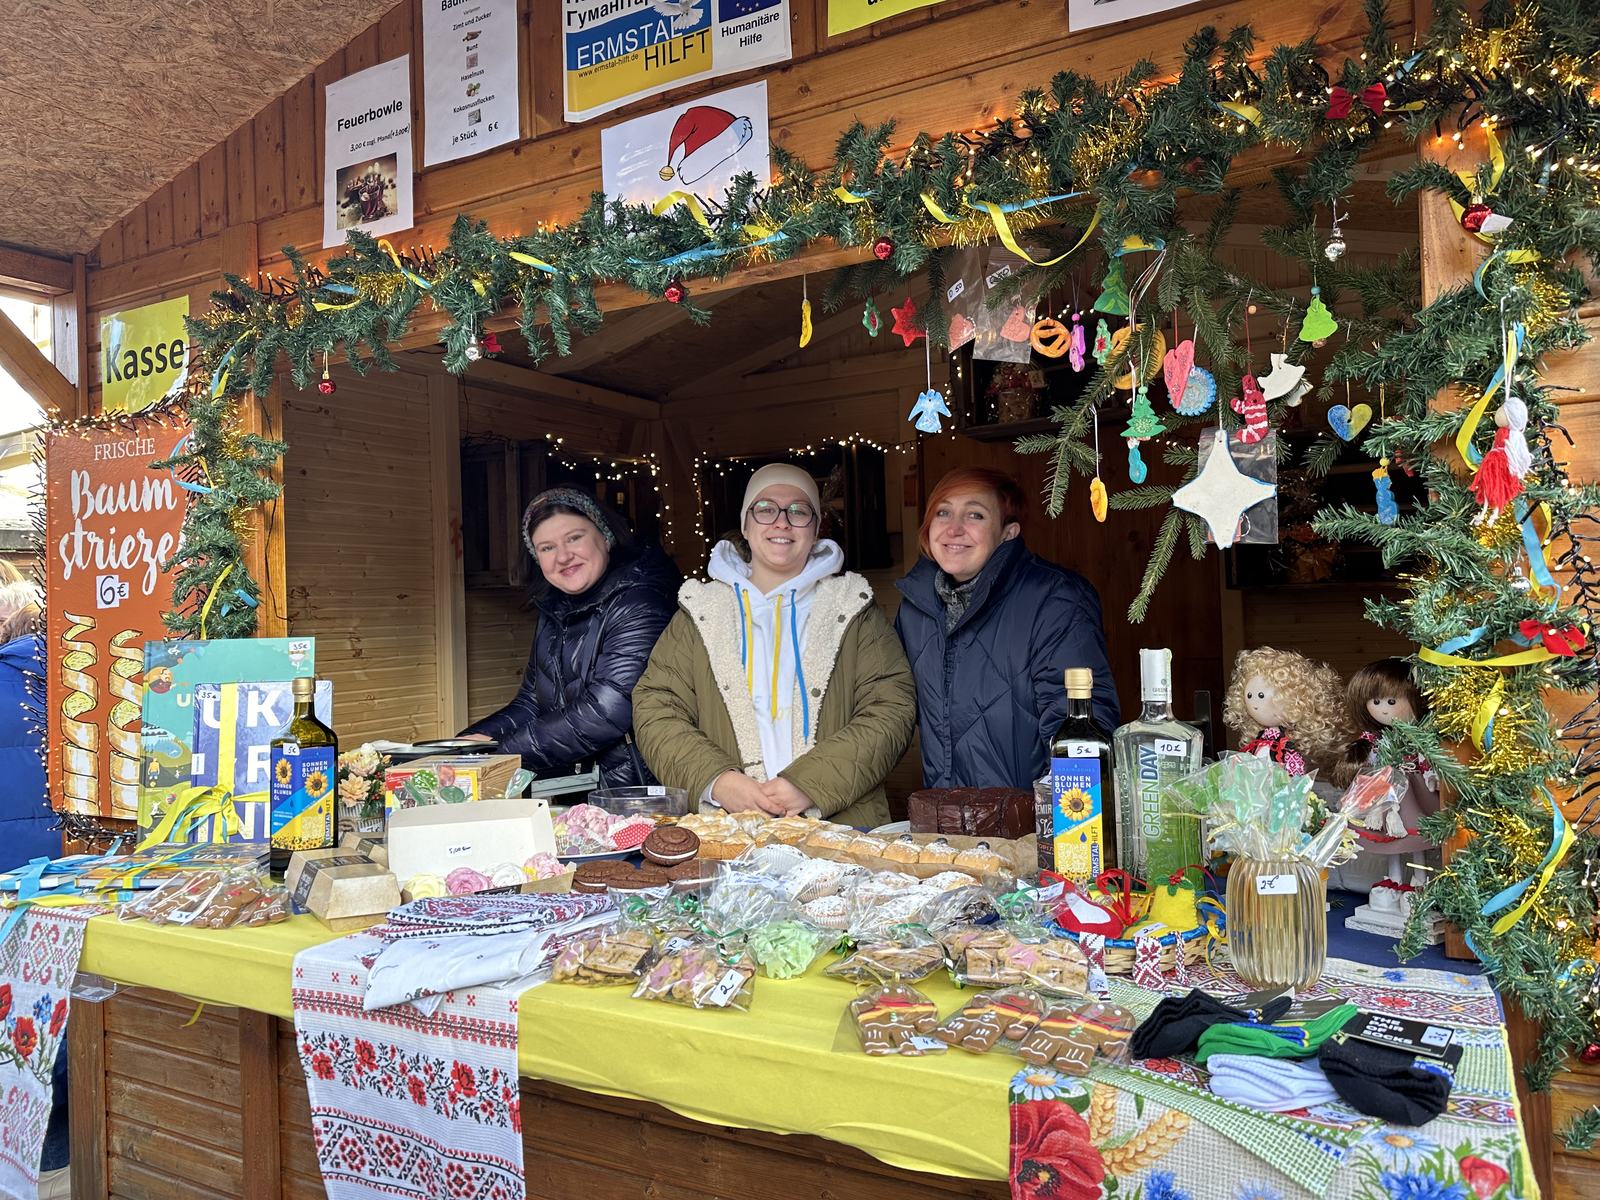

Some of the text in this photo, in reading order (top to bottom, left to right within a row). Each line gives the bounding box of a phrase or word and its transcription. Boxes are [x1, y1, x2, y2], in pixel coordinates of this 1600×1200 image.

[577, 16, 682, 70] ERMSTAL
[721, 12, 780, 38] Humanitäre
[739, 33, 763, 48] Hilfe
[645, 30, 709, 71] HILFT
[337, 99, 403, 132] Feuerbowle
[452, 121, 499, 145] je Stück 6 €
[106, 337, 185, 384] Kasse
[94, 437, 156, 461] FRISCHE
[71, 469, 178, 521] Baum
[59, 517, 187, 596] strieze
